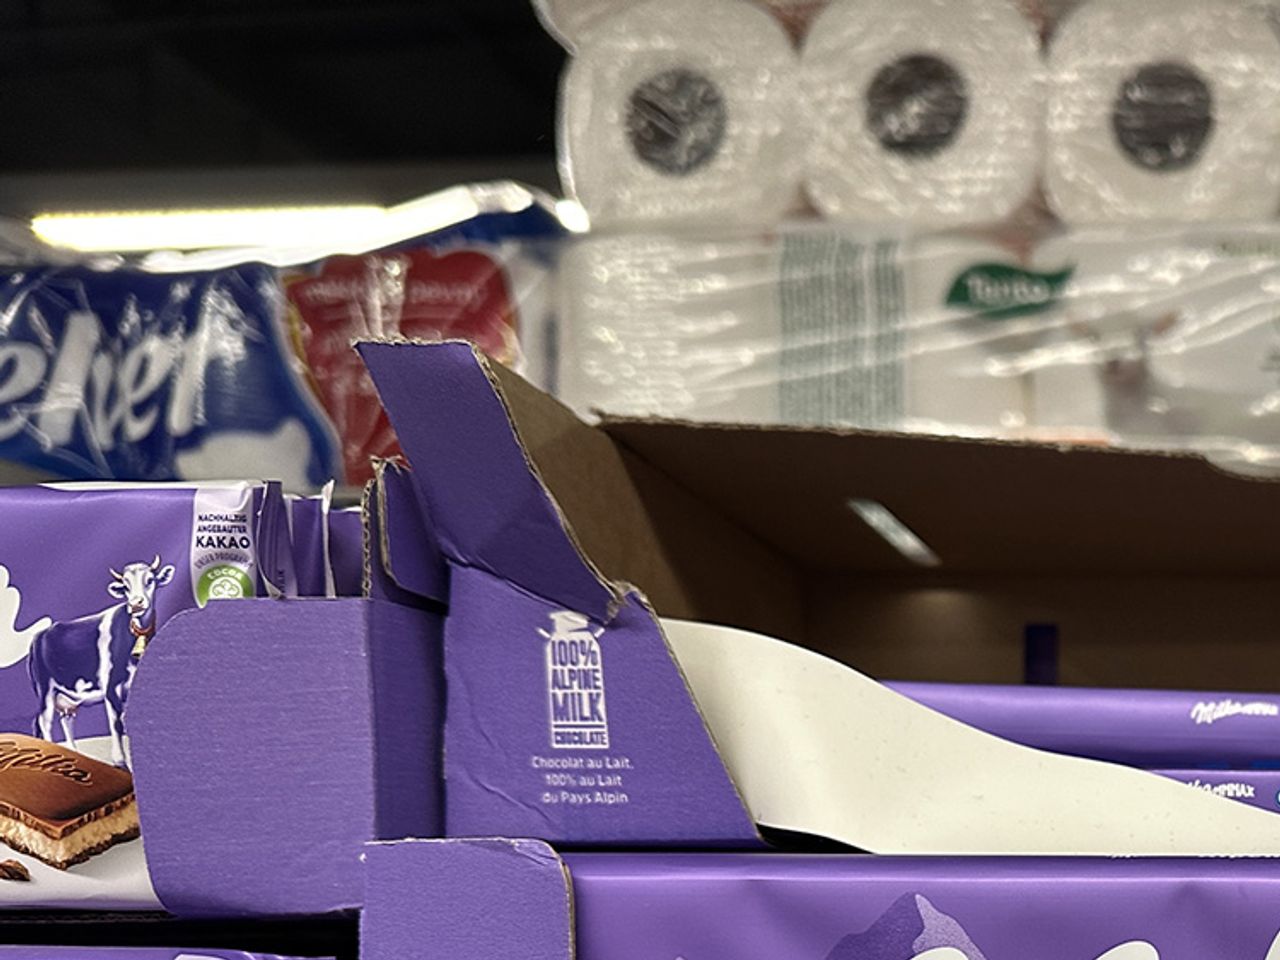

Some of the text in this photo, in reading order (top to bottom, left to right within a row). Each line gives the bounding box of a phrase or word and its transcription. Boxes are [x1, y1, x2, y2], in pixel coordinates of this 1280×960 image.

[196, 536, 250, 549] KAKAO
[207, 568, 243, 579] COCOA
[551, 640, 598, 666] 100%
[552, 668, 601, 690] ALPINE
[552, 692, 603, 721] MILK
[554, 731, 607, 745] CHOCOLATE
[532, 756, 584, 769] Chocolat
[586, 758, 603, 769] au
[545, 774, 622, 786] 100% au Lait
[542, 791, 629, 804] du Pays Alpin
